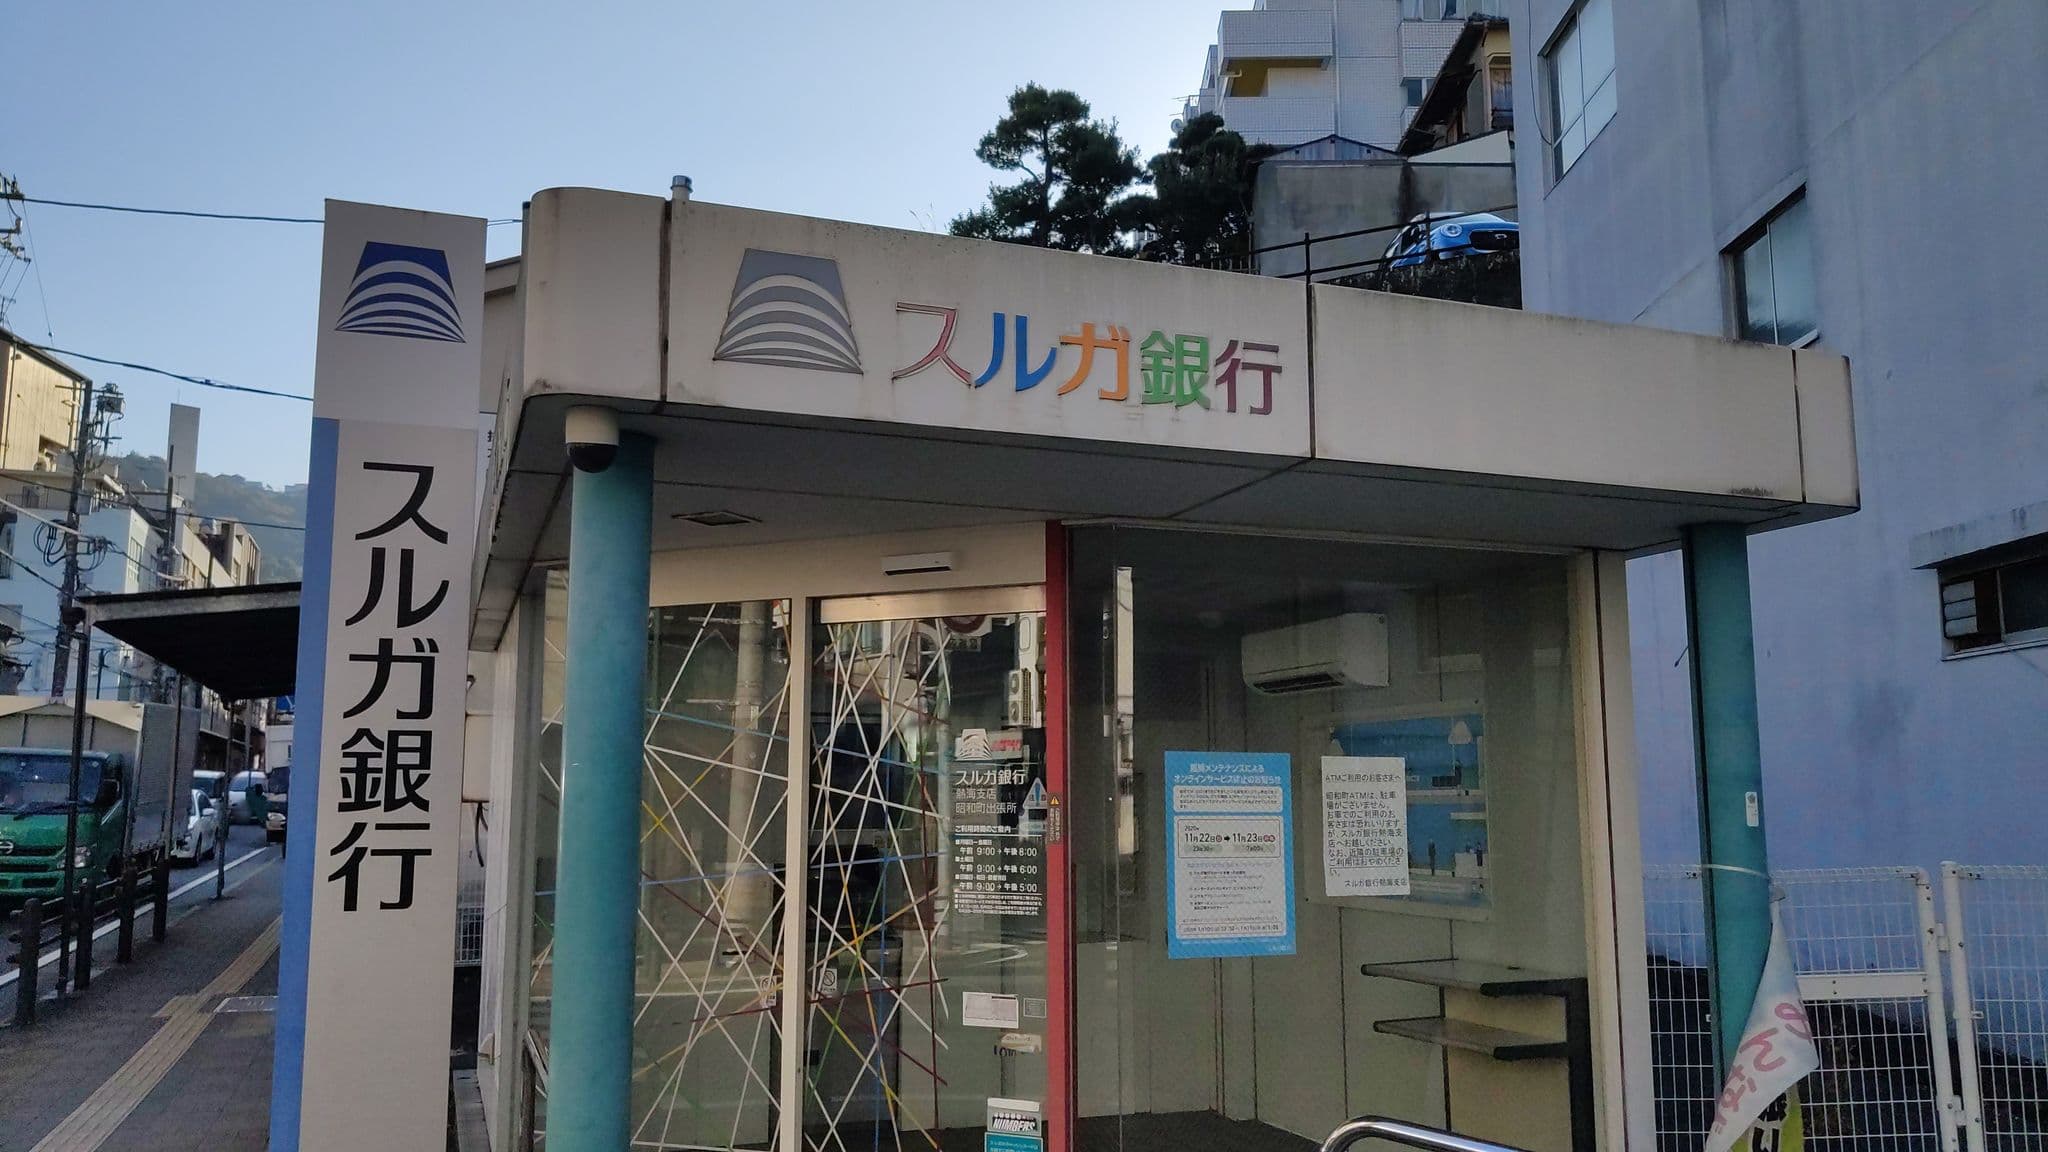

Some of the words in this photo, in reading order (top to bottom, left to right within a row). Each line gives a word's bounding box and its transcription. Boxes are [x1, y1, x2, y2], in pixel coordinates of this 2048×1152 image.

[891, 301, 1283, 416] スルガ銀行
[328, 461, 450, 912] スルガ銀行
[1190, 763, 1265, 773] メンテナンスによる
[955, 769, 1026, 785] スルガ銀行
[1325, 774, 1401, 783] ATMご利用のお客さまへ
[955, 788, 997, 800] 熱海支店
[955, 802, 1017, 815] 昭和町出張所
